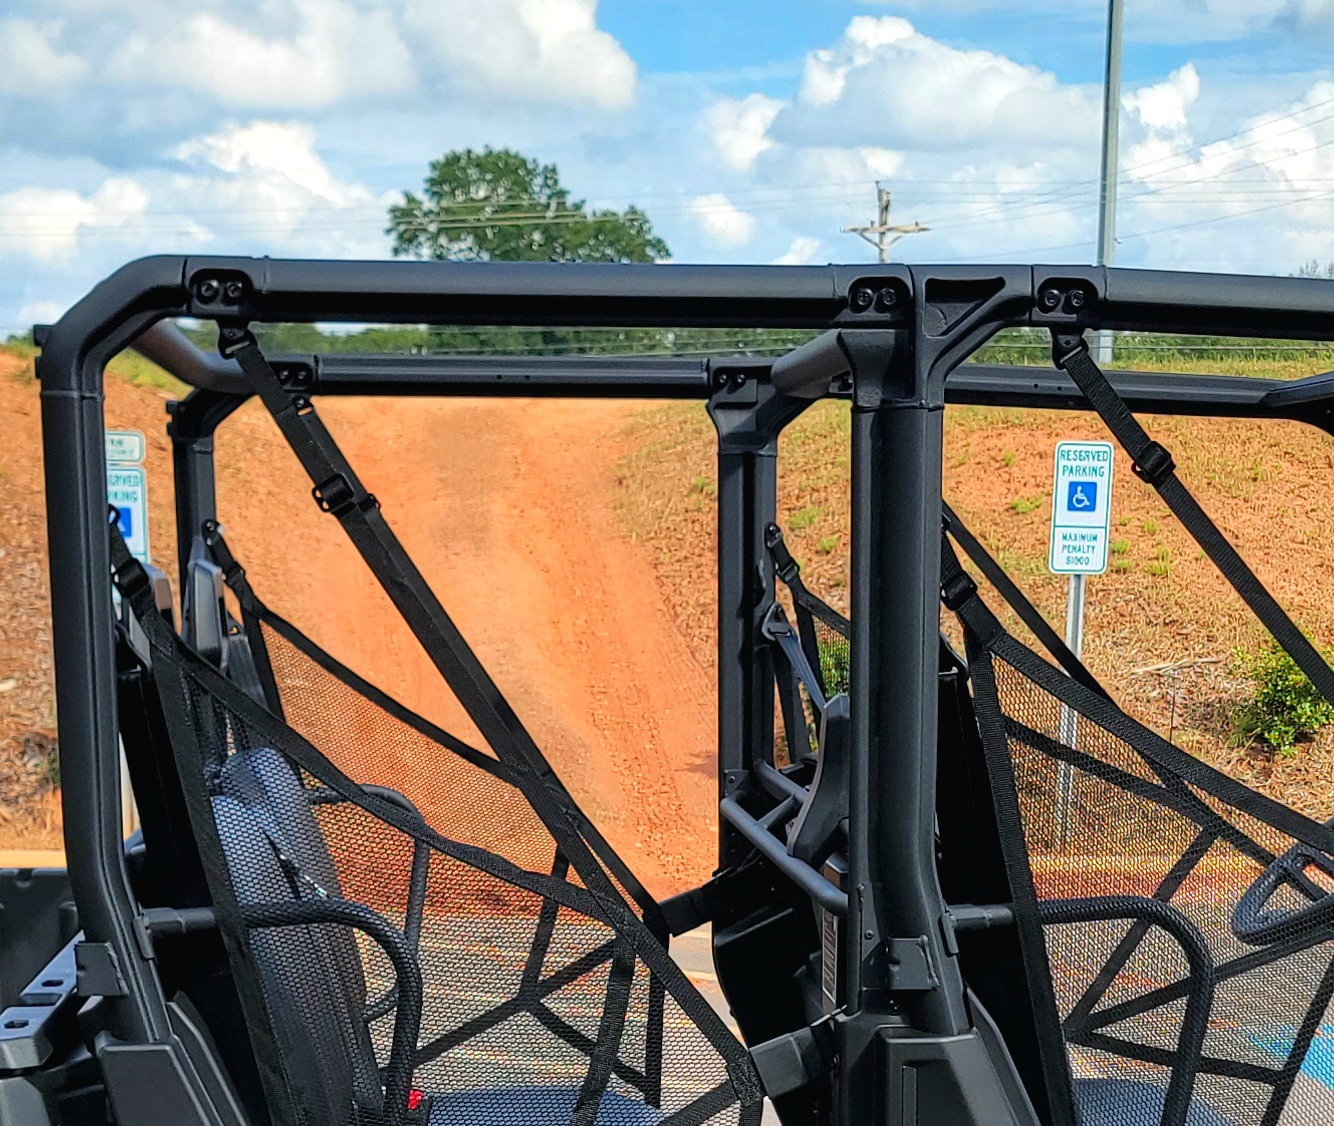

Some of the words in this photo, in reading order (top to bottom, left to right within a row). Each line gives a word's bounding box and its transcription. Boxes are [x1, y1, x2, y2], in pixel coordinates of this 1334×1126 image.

[1060, 450, 1109, 461] RESERVED
[1062, 465, 1105, 478] PARKING
[1062, 533, 1098, 542] MAXIMUM
[1062, 544, 1096, 554] PENALTY
